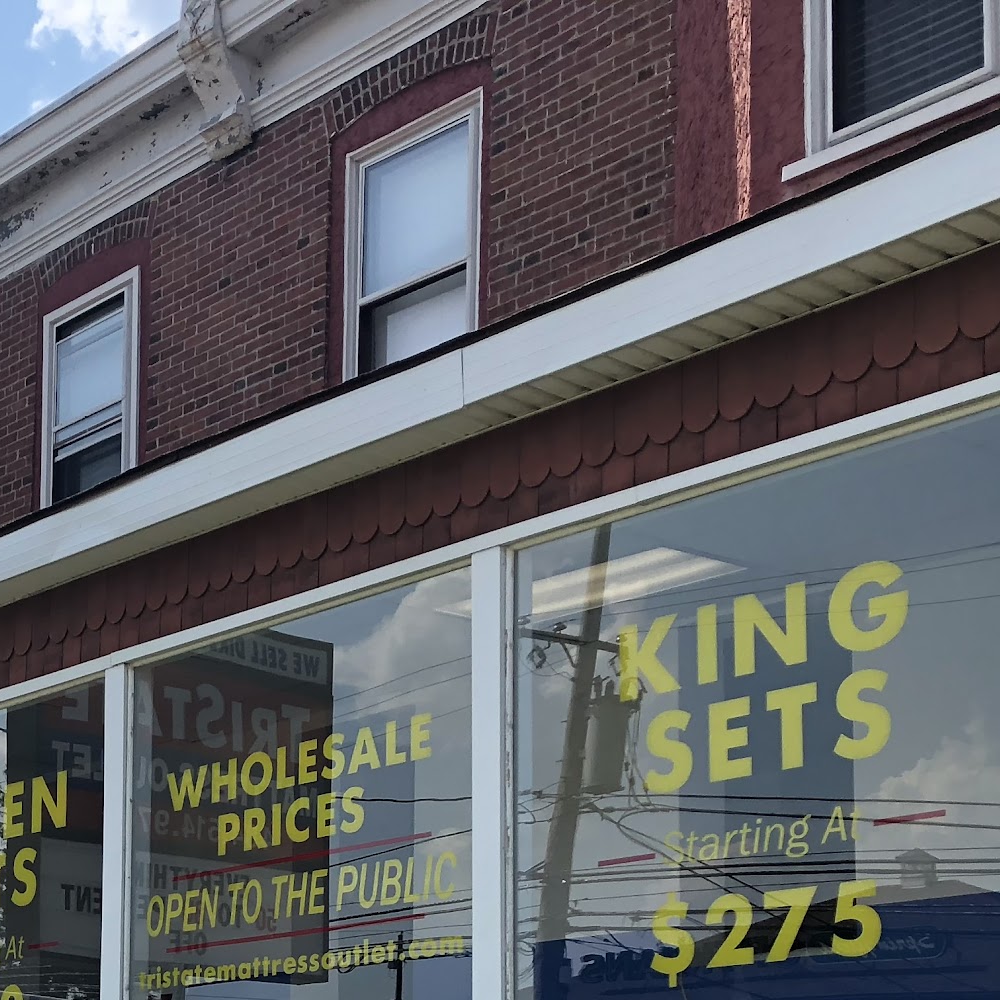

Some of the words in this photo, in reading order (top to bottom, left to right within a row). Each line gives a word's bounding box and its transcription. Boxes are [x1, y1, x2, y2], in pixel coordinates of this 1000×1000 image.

[618, 560, 909, 701] KING
[167, 712, 432, 812] WHOLESALE
[644, 669, 893, 794] SETS
[218, 786, 366, 857] PRICES
[661, 813, 809, 867] Starting
[820, 806, 863, 845] At
[147, 886, 219, 938] OPEN
[228, 879, 263, 926] TO
[272, 869, 328, 920] THE
[336, 851, 458, 910] PUBLIC
[650, 879, 883, 988] $275
[5, 936, 24, 960] At
[139, 935, 465, 990] tristatemattressoutlet.com
